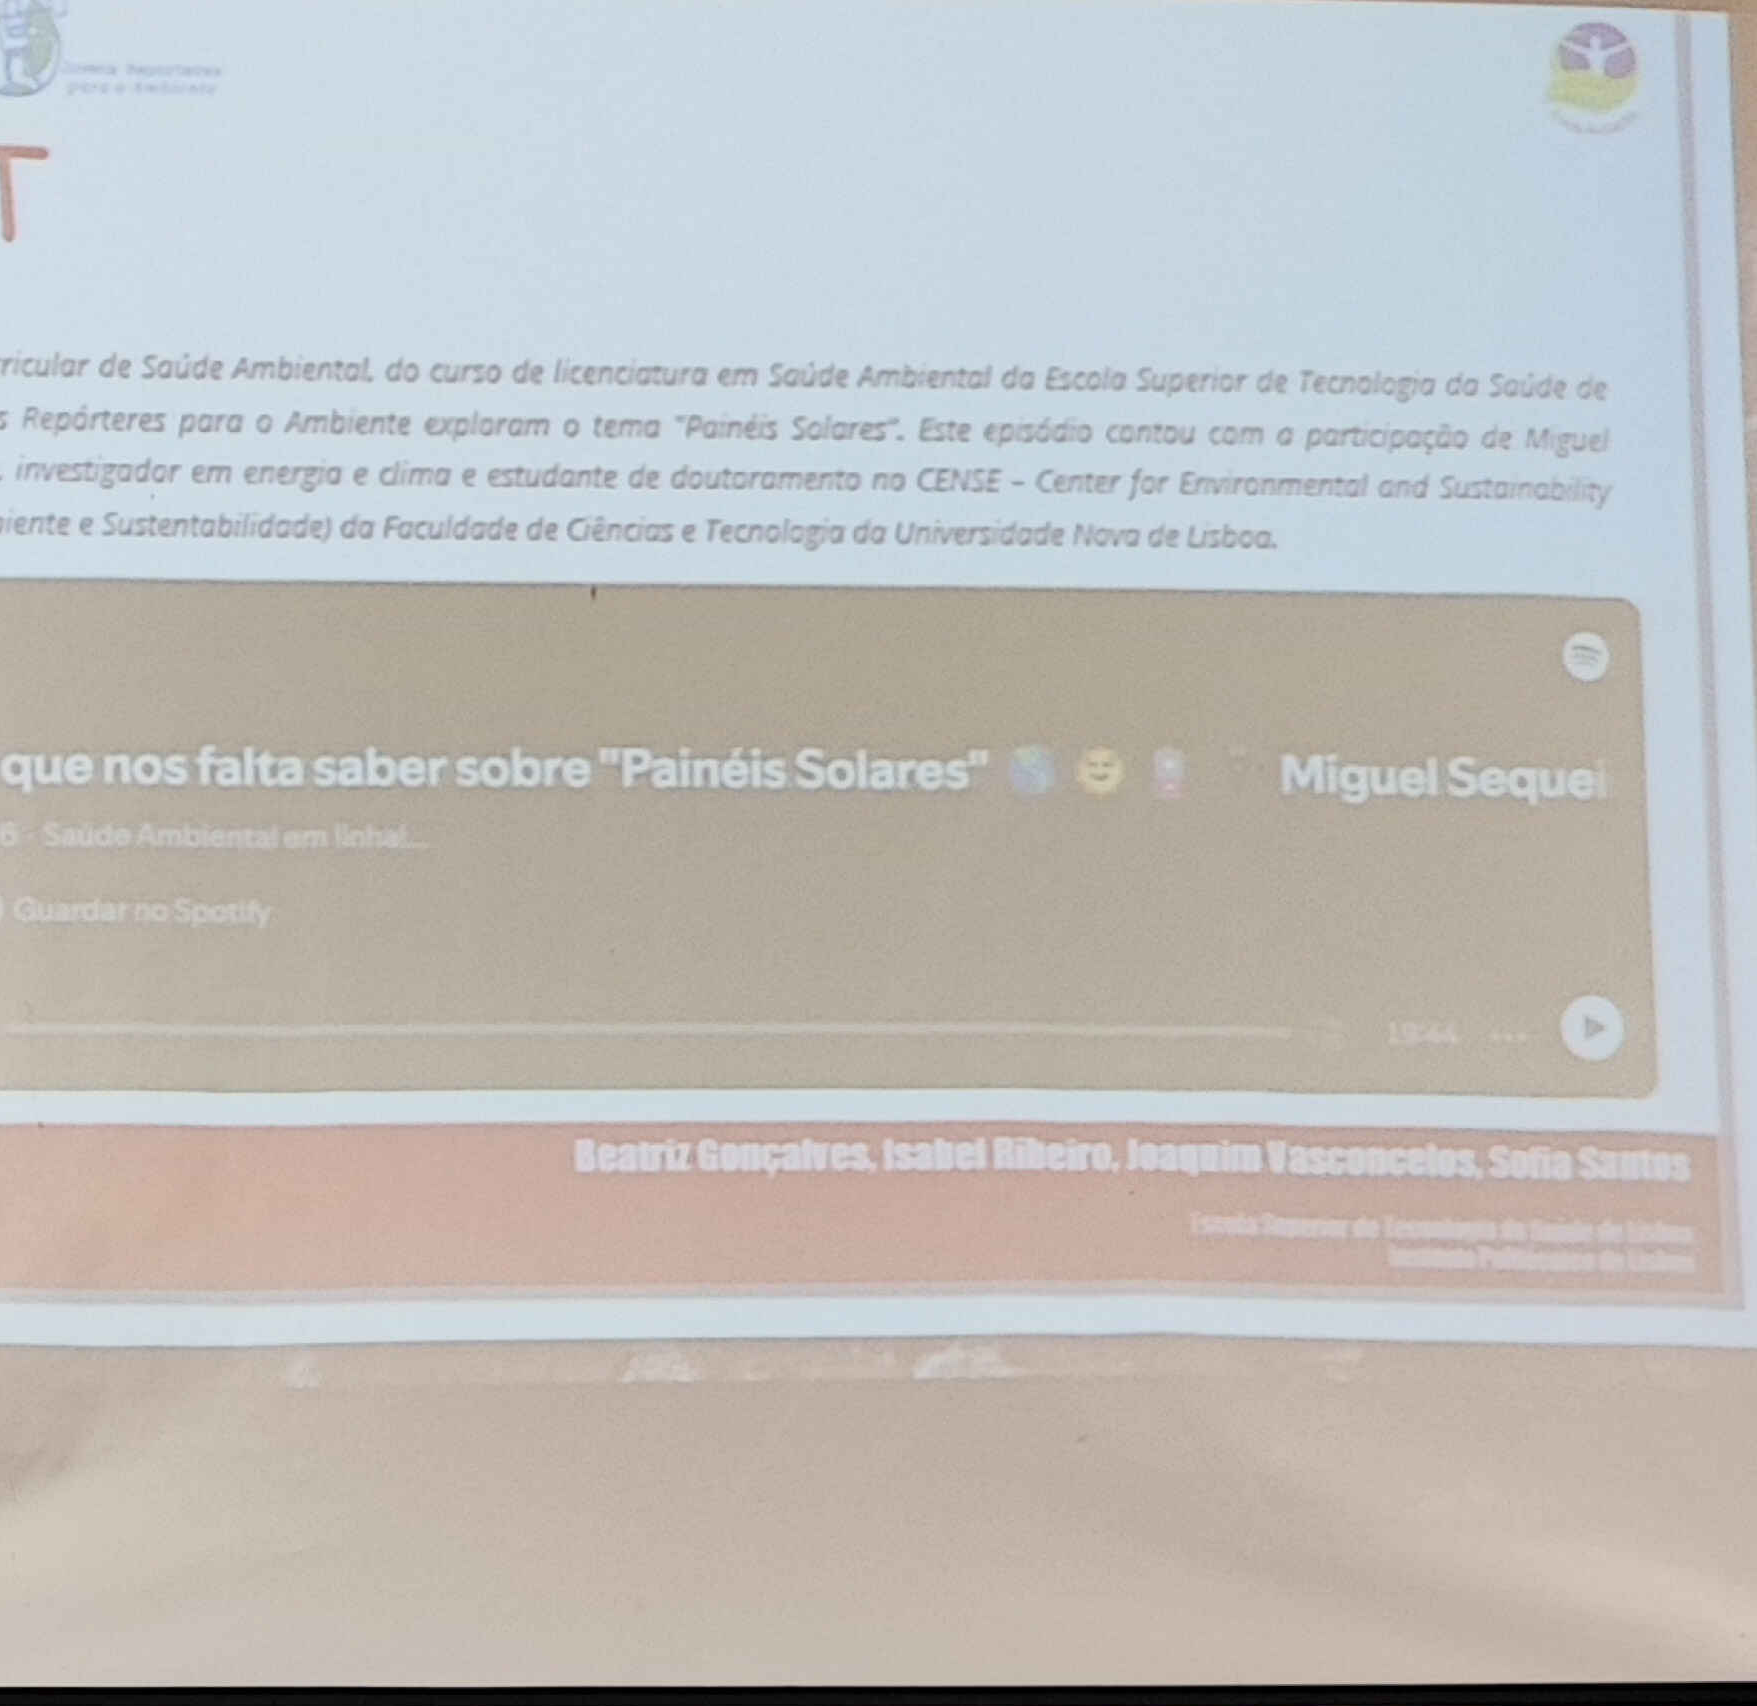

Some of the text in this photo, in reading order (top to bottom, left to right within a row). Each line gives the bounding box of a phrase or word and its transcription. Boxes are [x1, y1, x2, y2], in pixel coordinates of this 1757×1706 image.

[100, 354, 133, 380] de
[142, 354, 224, 381] Saúde
[385, 357, 420, 384] do
[430, 363, 502, 385] curso
[512, 358, 544, 385] de
[553, 359, 709, 386] licenciatura
[717, 368, 758, 388] em
[768, 362, 849, 389] Saúde
[856, 363, 992, 390] Ambiental
[1000, 366, 1035, 391] da
[1045, 366, 1127, 392] Escola
[1136, 368, 1248, 398] Superior
[1257, 369, 1289, 394] de
[1299, 369, 1436, 403] Tecnologia
[1445, 371, 1480, 398] da
[1488, 371, 1568, 399] Saúde
[1575, 373, 1608, 401] de
[21, 405, 166, 437] Repórteres
[177, 413, 243, 439] para
[254, 412, 274, 434] o
[286, 409, 412, 436] Ambiente
[424, 411, 550, 442] exploram
[562, 417, 580, 438] o
[592, 415, 661, 439] tema
[918, 417, 972, 443] Este
[983, 417, 1094, 449] episódio
[1105, 424, 1196, 448] contou
[1207, 427, 1264, 448] com
[1275, 427, 1294, 448] a
[1305, 423, 1470, 456] participação
[1481, 425, 1513, 450] de
[1524, 425, 1612, 458] Miguel
[0, 752, 93, 795] que
[102, 753, 187, 787] nos
[196, 744, 304, 788] falta
[313, 747, 447, 789] saber
[455, 748, 591, 790] sobre
[1282, 753, 1440, 804] Miguel
[139, 820, 280, 850] Ambiental
[283, 829, 329, 850] em
[12, 897, 274, 930] Guardar no Spotify
[574, 1138, 691, 1172] Beatriz
[884, 1138, 985, 1172] Isabel
[1126, 1138, 1263, 1176] Joaquim
[1489, 1144, 1575, 1181] Sofia
[1580, 1146, 1692, 1184] Santos
